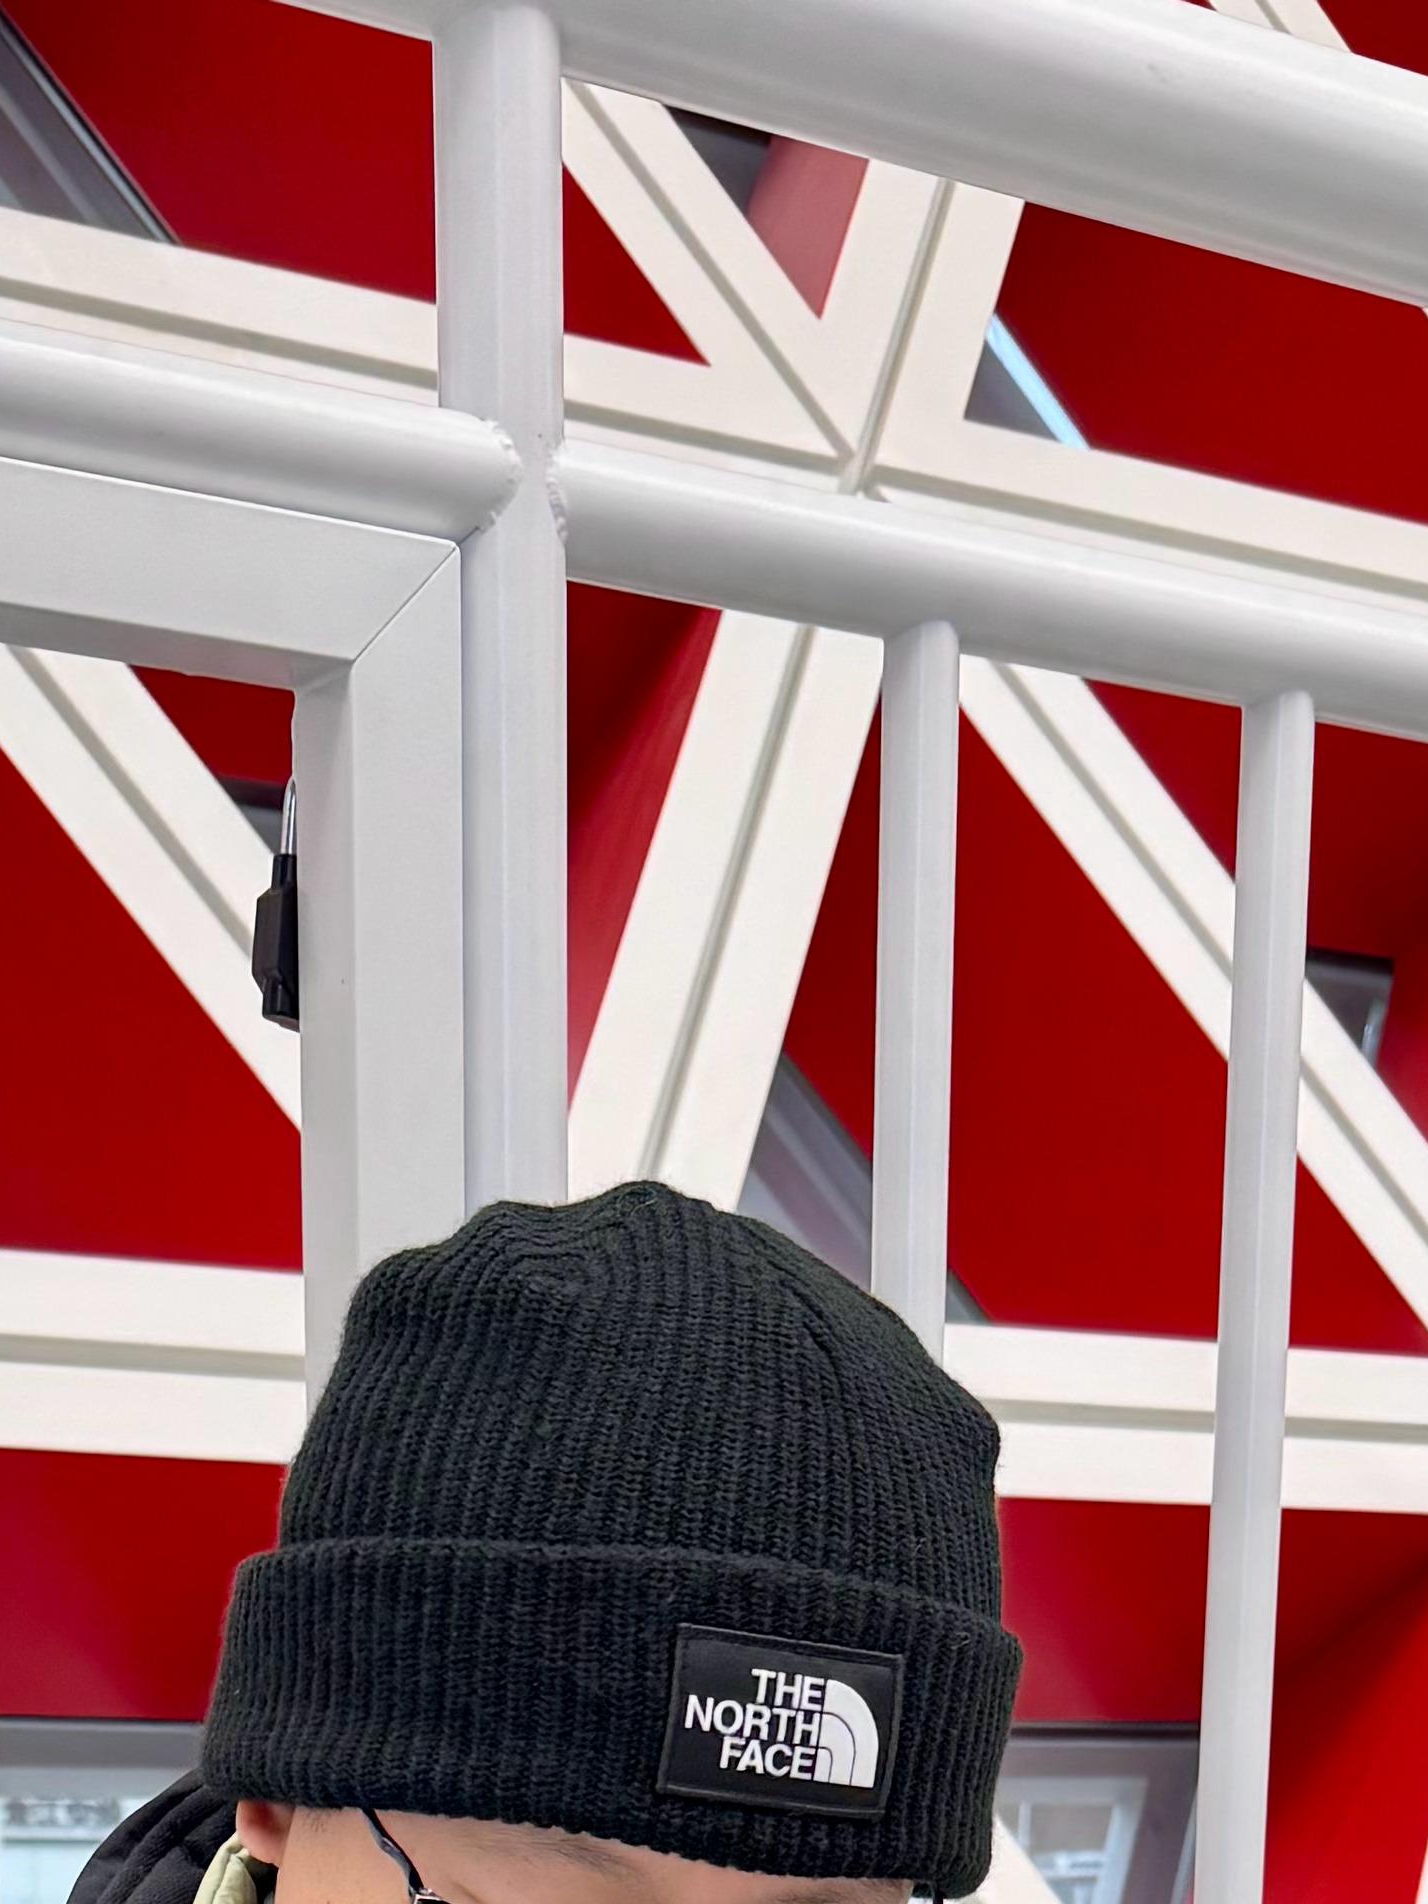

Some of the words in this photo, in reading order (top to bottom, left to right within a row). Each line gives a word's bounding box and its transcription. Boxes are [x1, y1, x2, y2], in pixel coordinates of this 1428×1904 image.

[751, 1668, 824, 1711] THE
[684, 1694, 821, 1747] NORTH
[719, 1736, 816, 1780] FACE
